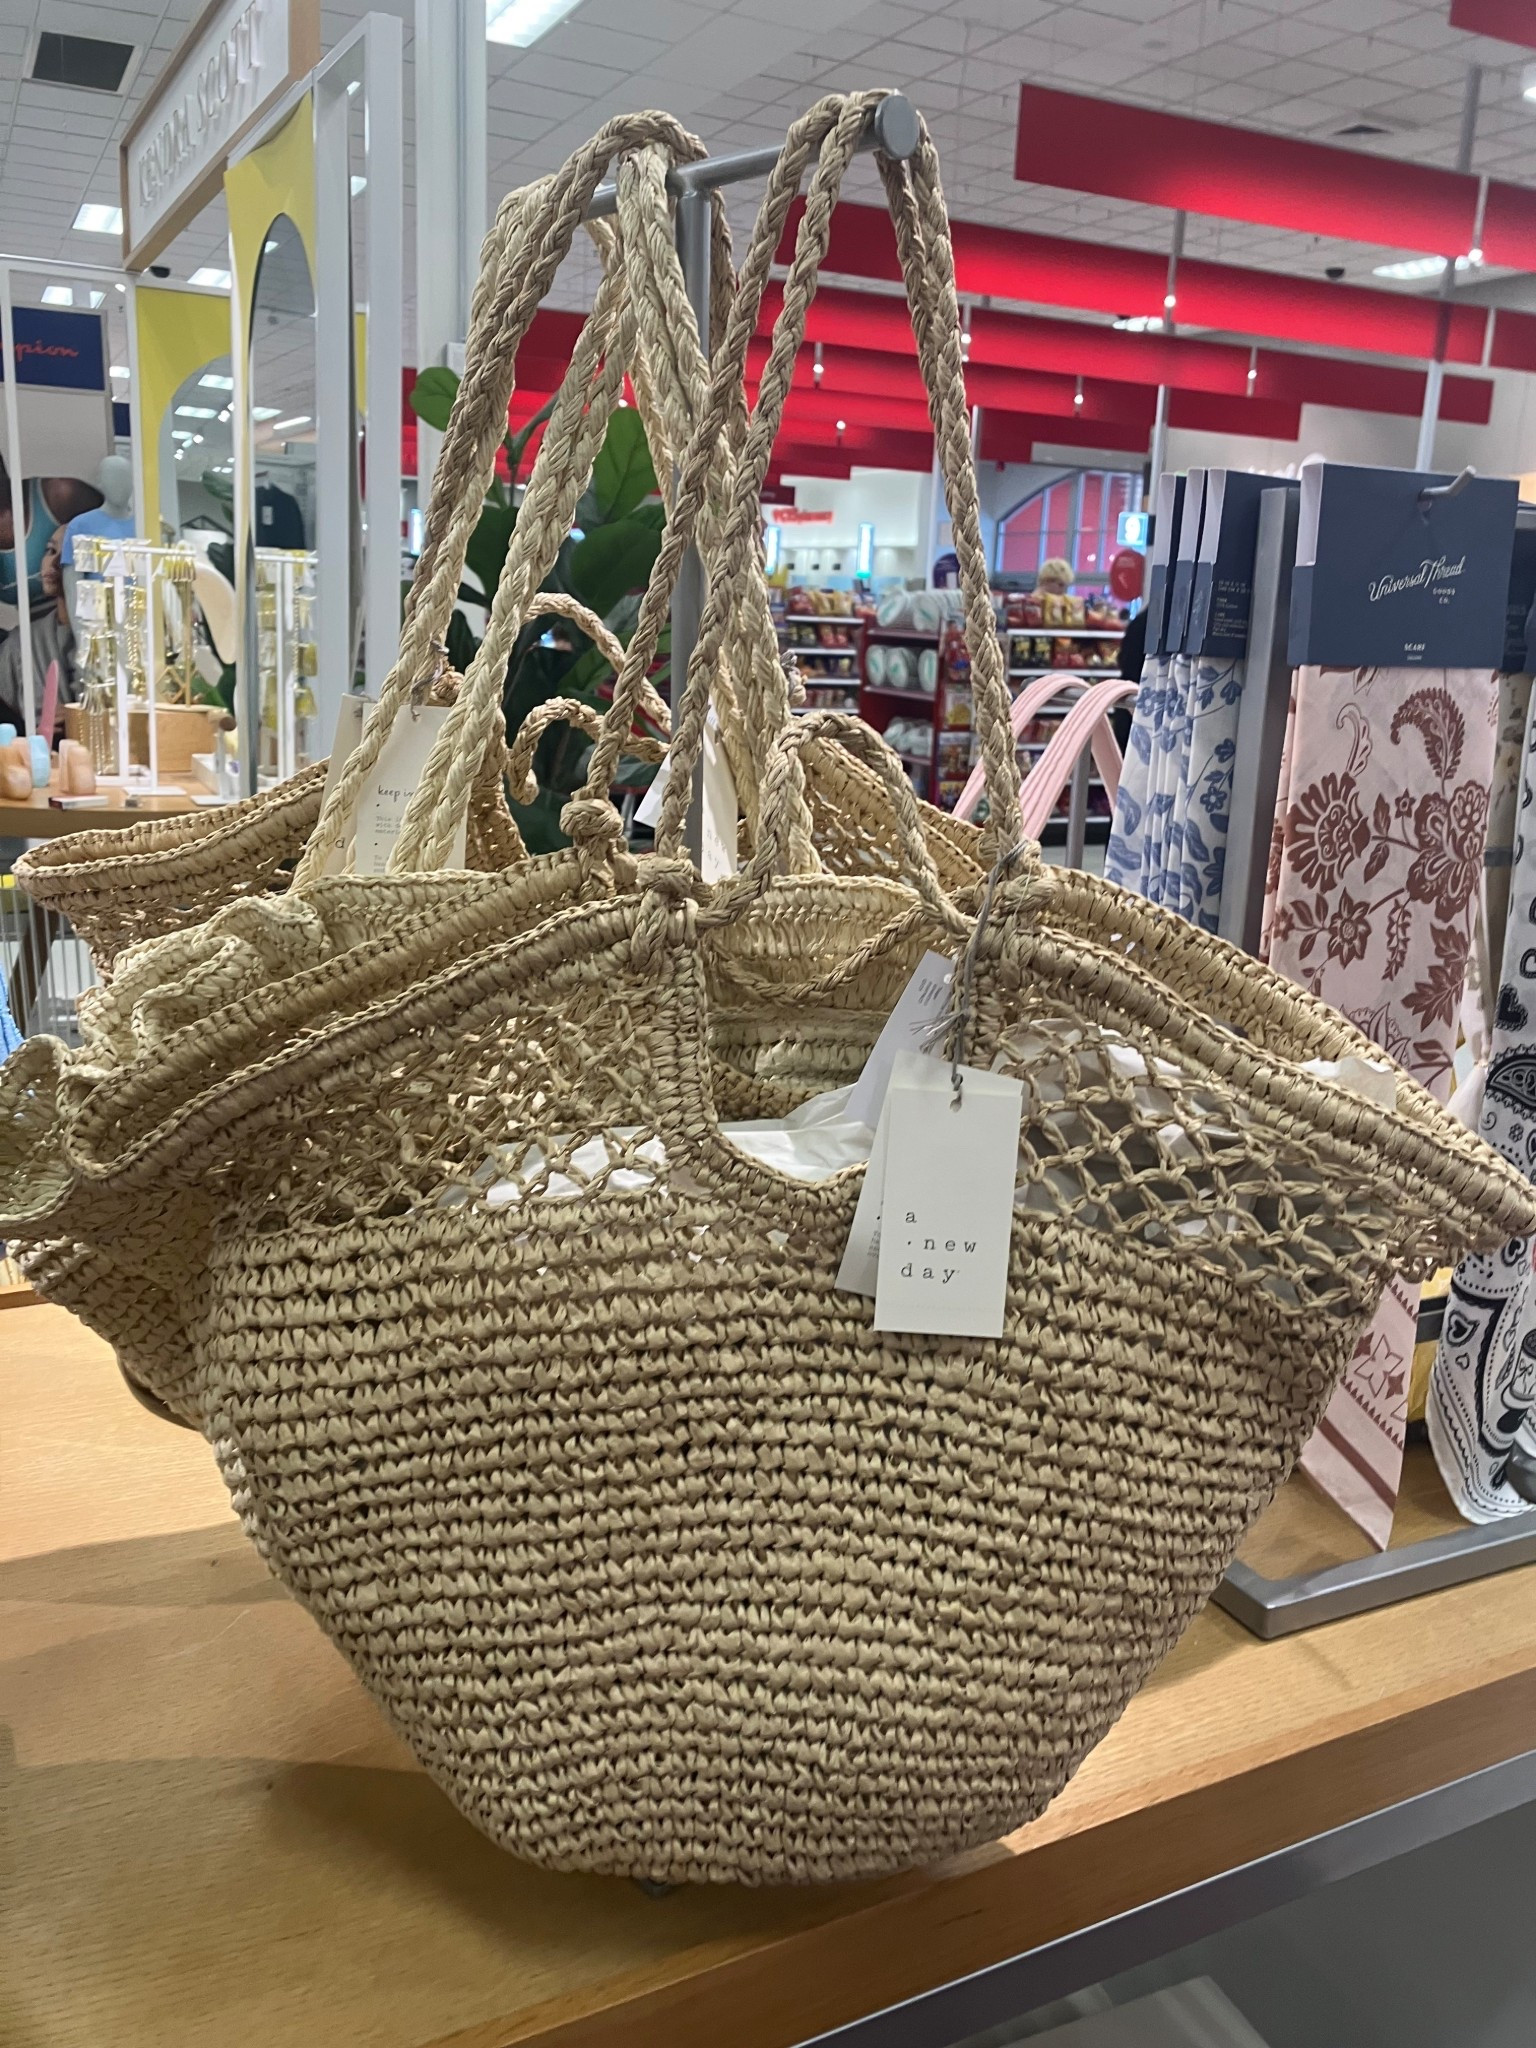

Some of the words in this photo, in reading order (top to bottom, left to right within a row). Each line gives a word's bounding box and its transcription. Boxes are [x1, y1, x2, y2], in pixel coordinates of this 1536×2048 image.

[196, 0, 264, 134] SCOTT
[1125, 515, 1141, 544] 9
[1368, 563, 1428, 602] Universal
[1419, 555, 1466, 589] Thread
[378, 785, 400, 803] keep
[905, 1211, 917, 1224] a
[900, 1262, 956, 1284] day
